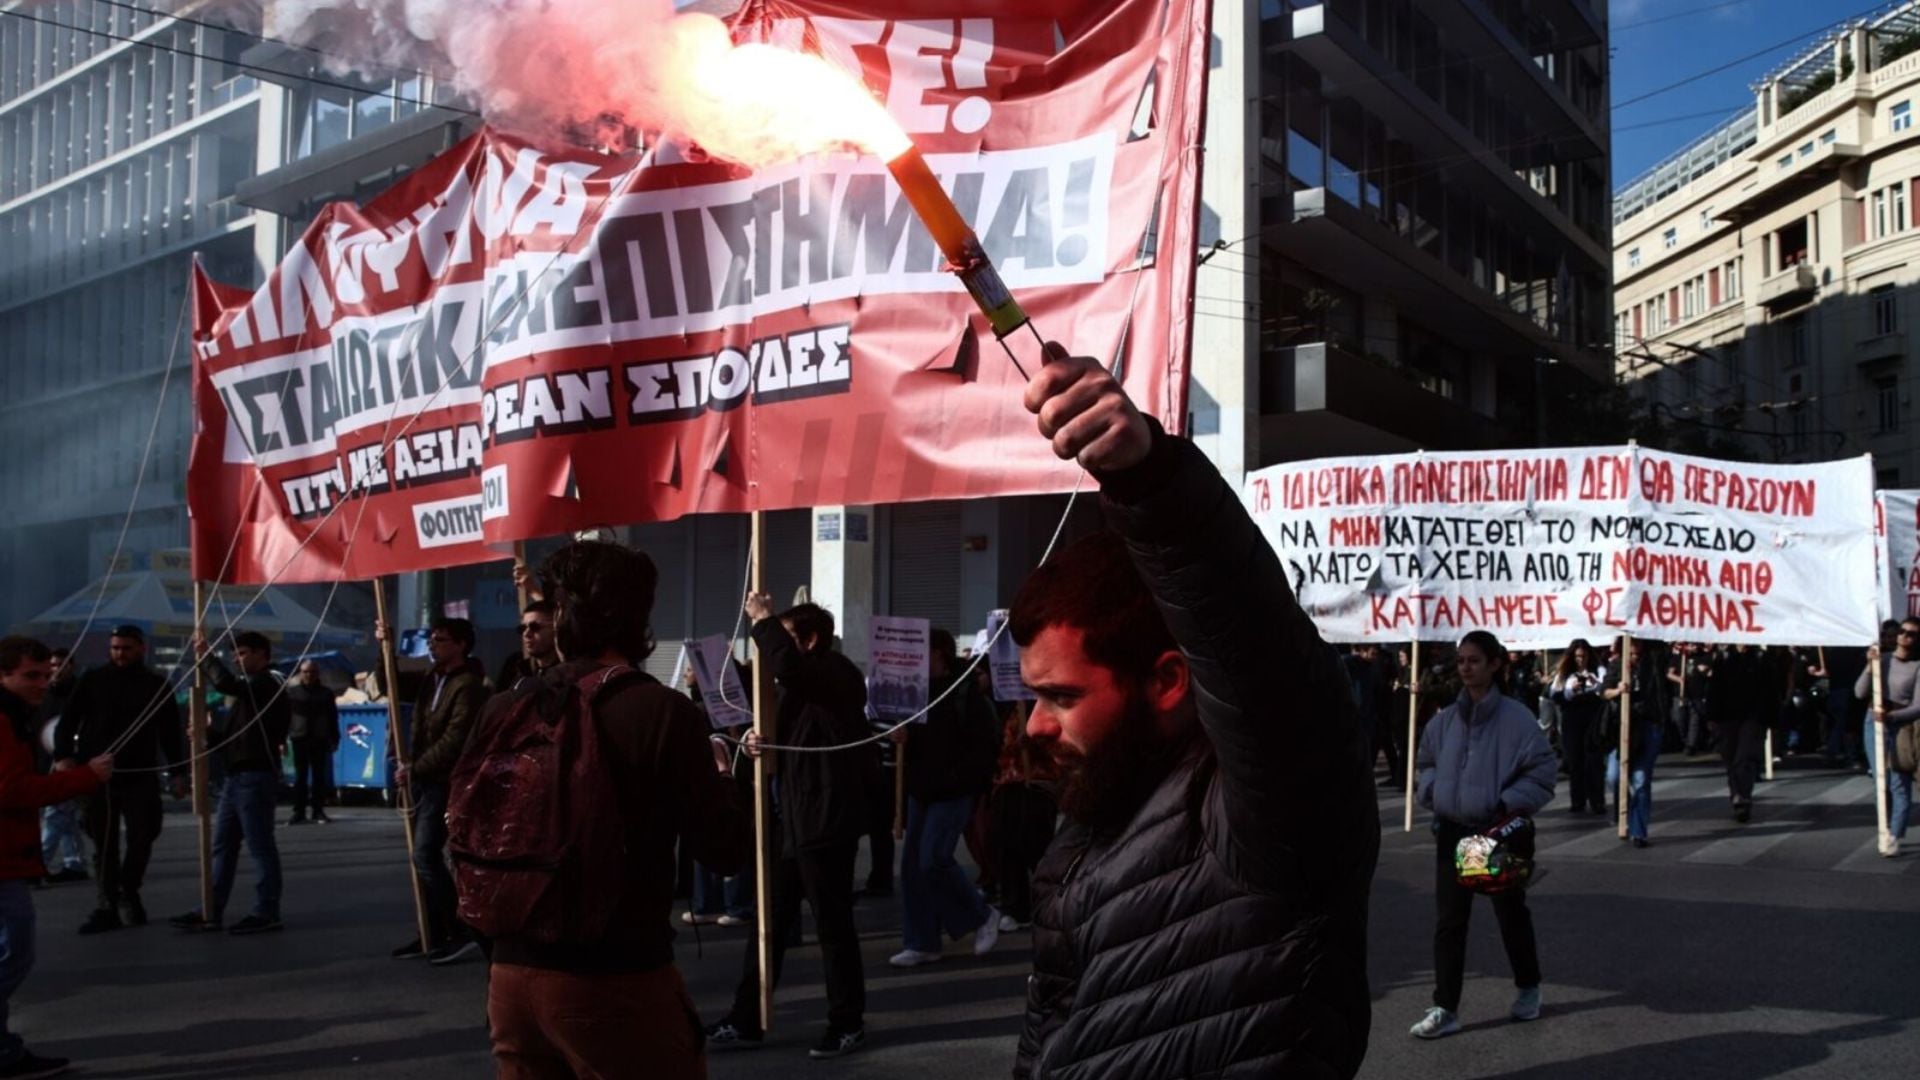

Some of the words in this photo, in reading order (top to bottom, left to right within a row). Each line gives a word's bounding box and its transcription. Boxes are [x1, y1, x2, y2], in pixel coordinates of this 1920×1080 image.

[348, 444, 389, 490] ΜΕ
[394, 425, 482, 481] ΑΞΙΑ
[1252, 477, 1271, 514] ΤΑ
[1282, 466, 1386, 510] ΙΔΙΩΤΙΚΑ
[1393, 458, 1568, 505] ΠΑΝΕΠΙΣΤΗΜΙΑ
[1578, 456, 1631, 500] ΔΕΝ
[1639, 458, 1674, 504] ΘΑ
[1684, 464, 1816, 518] ΠΕΡΑΣΟΥΝ
[1281, 520, 1319, 549] ΝΑ
[1328, 516, 1381, 547] ΜΗΝ
[1384, 516, 1524, 548] ΚΑΤΑΤΕΘΕΙ
[1541, 518, 1575, 545] ΤΟ
[1590, 515, 1755, 553] ΝΟΜΟΣΧΕΔΙΟ
[1308, 551, 1372, 585] ΚΑΤΩ
[1386, 552, 1423, 579] ΤΑ
[1430, 550, 1512, 582] ΧΕΡΙΑ
[1523, 553, 1570, 582] ΑΠΟ
[1577, 552, 1602, 582] ΤΗ
[1612, 546, 1712, 588] ΝΟΜΙΚΗ
[1719, 559, 1773, 596] ΑΠΘ
[1370, 593, 1568, 631] ΚΑΤΑΛΗΨΕΙΣ
[1582, 587, 1627, 627] ΦΣ
[1636, 591, 1764, 633] ΑΘΗΝΑΣ
